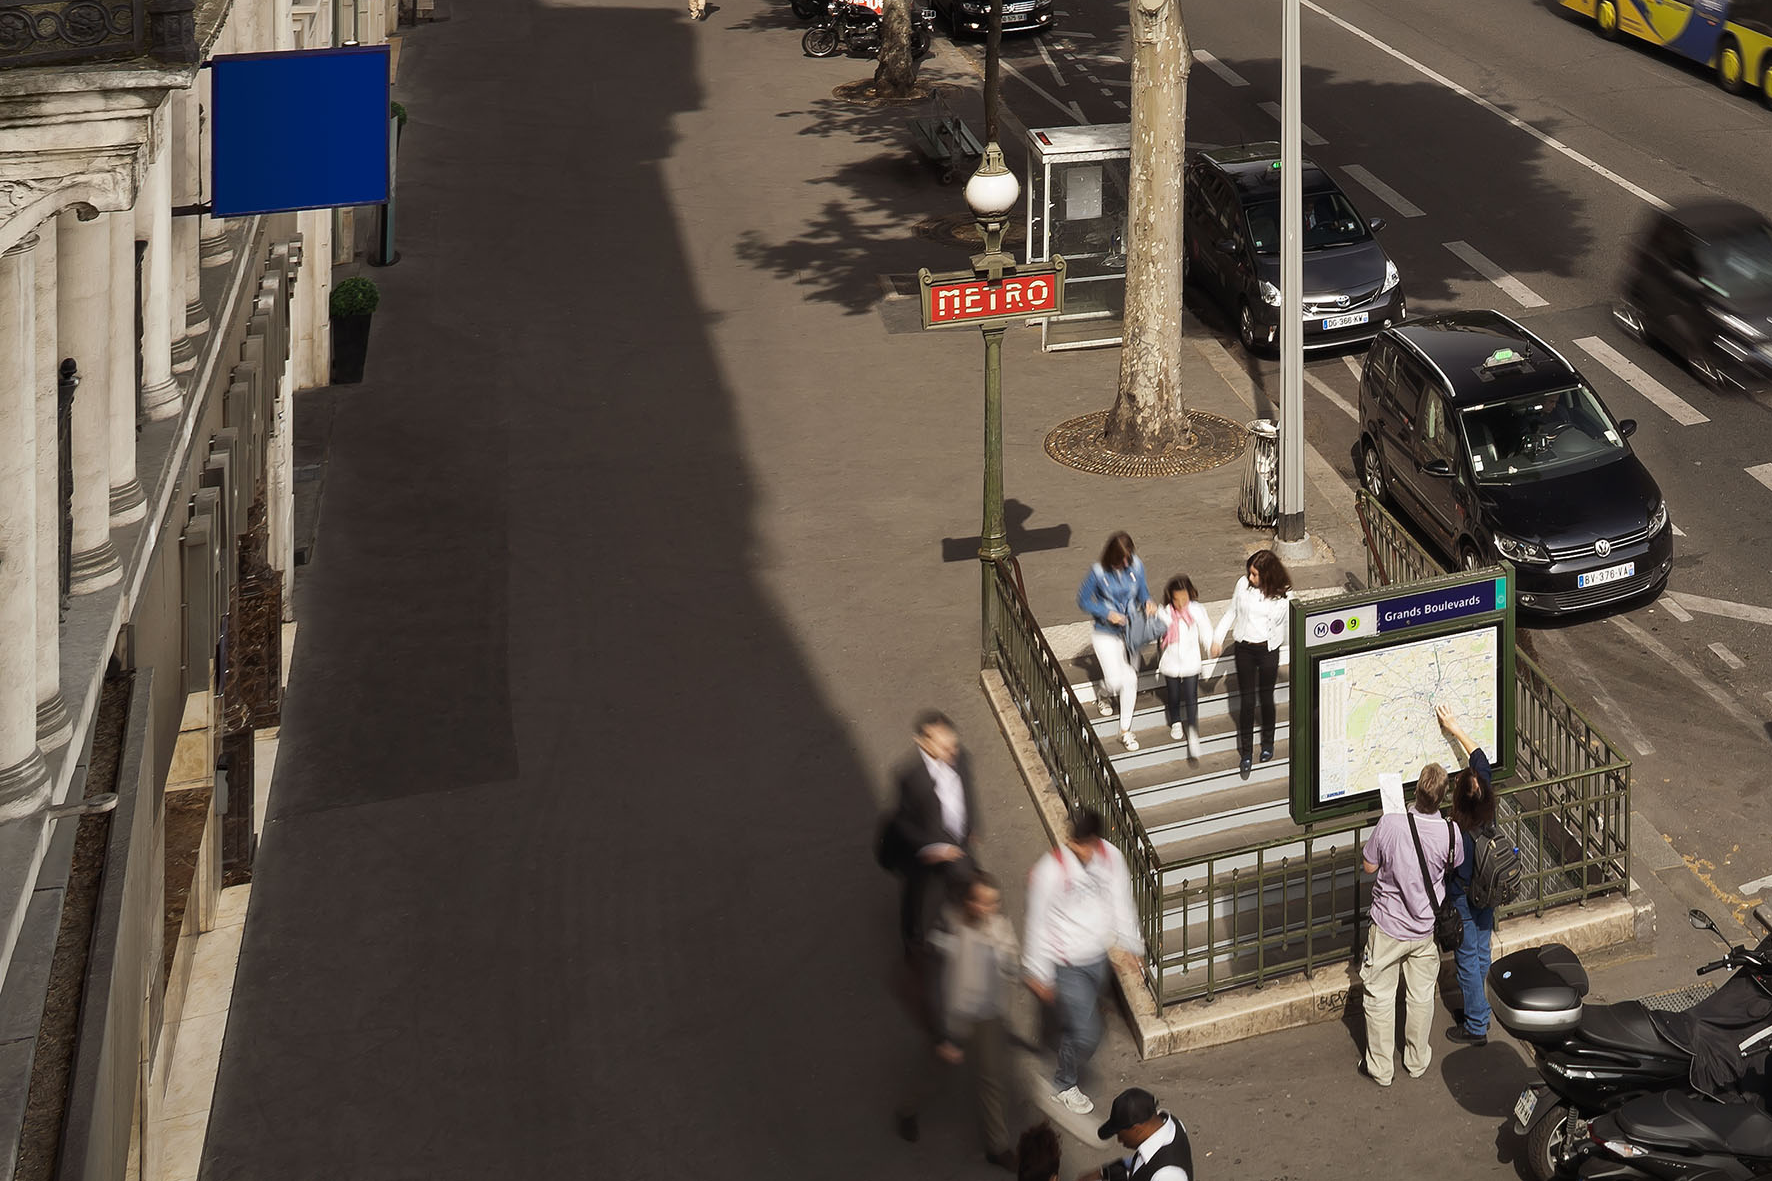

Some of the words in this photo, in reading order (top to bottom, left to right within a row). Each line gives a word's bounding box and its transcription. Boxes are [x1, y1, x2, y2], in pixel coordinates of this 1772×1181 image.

[939, 279, 1049, 316] METRO
[1384, 606, 1422, 622] Grands
[1424, 595, 1481, 615] Boulevards
